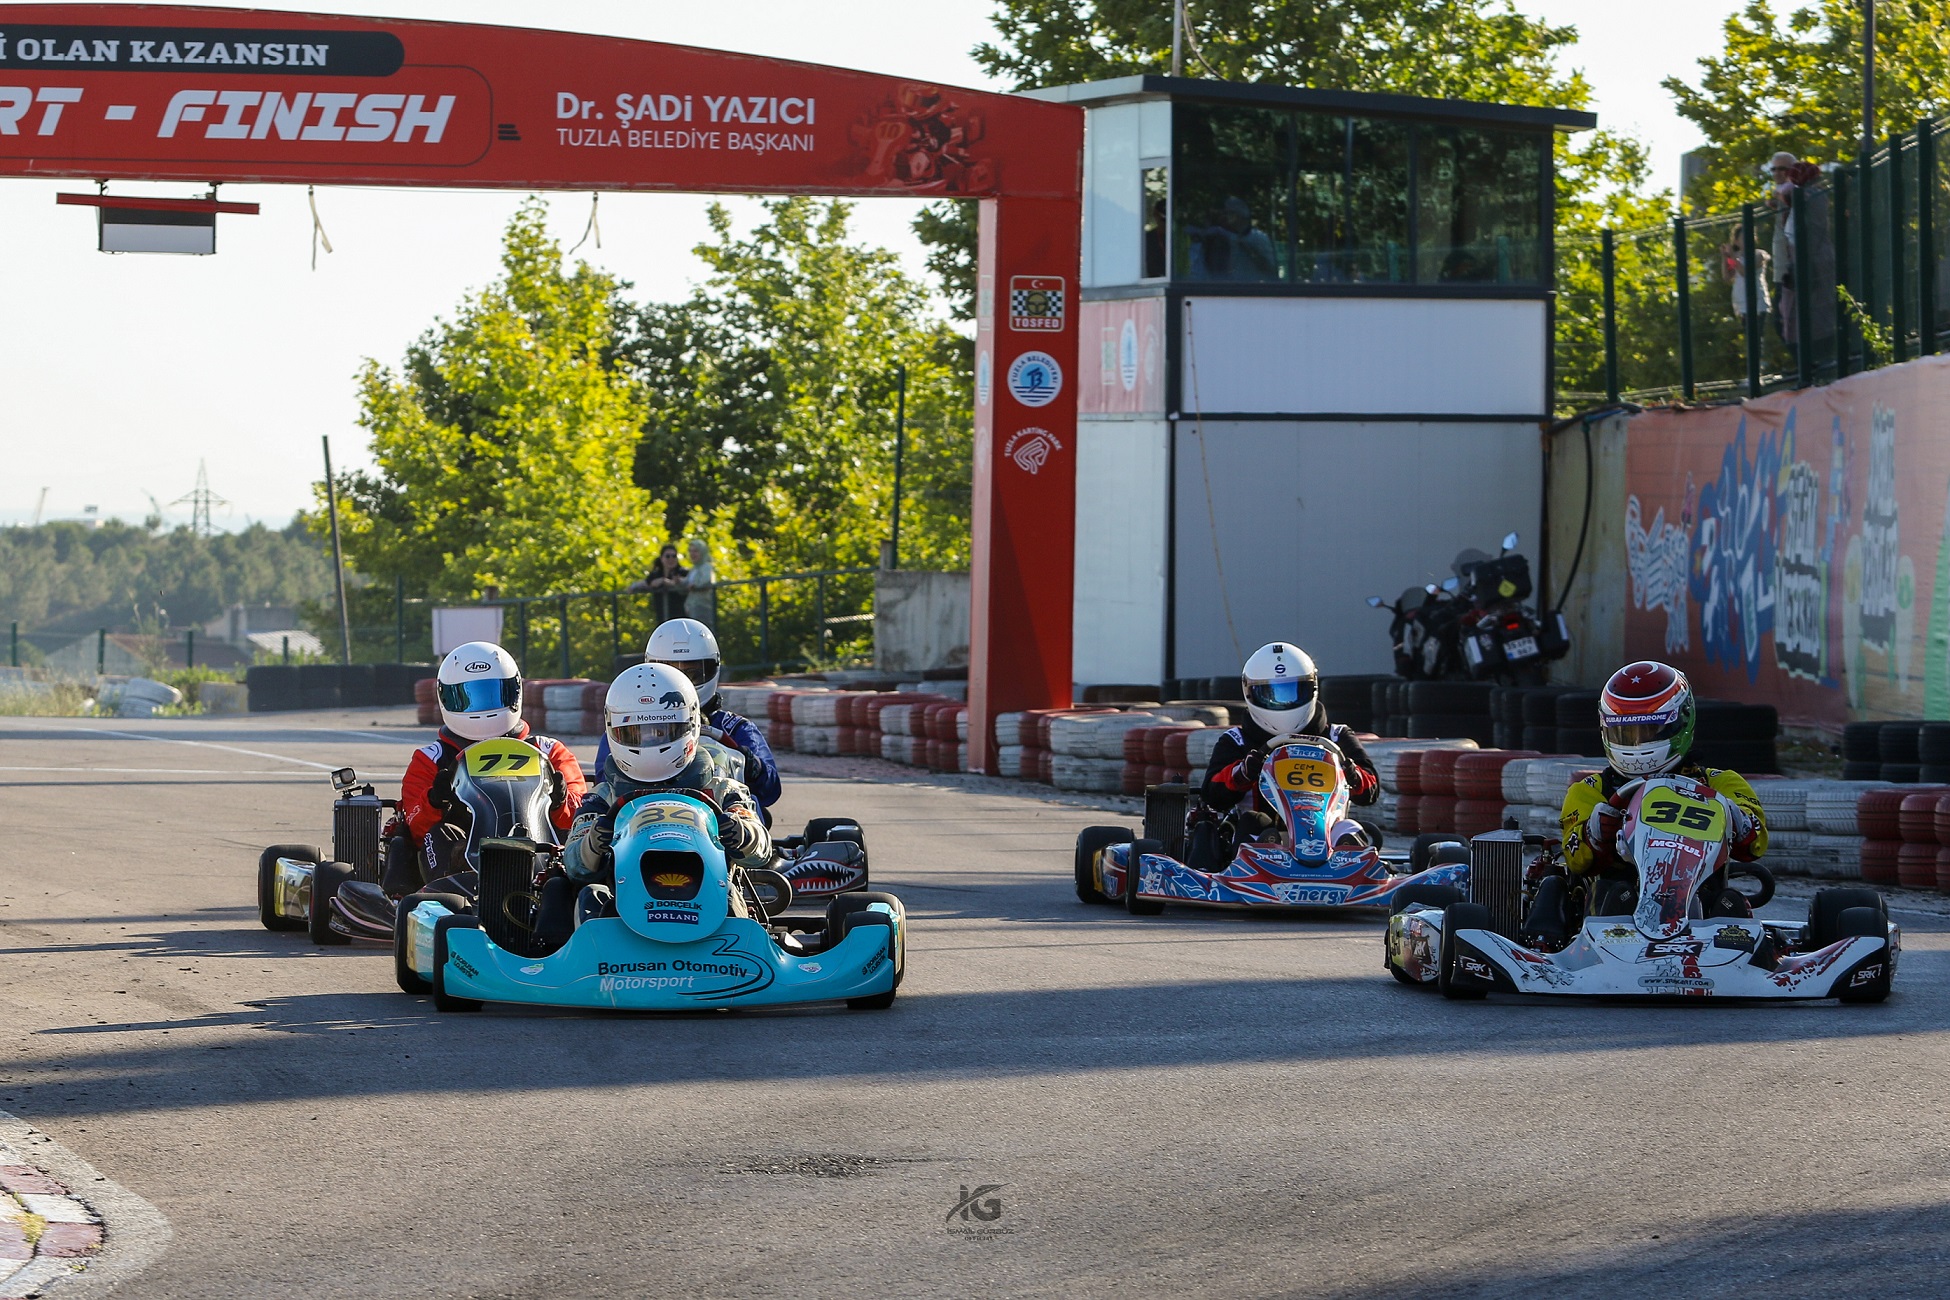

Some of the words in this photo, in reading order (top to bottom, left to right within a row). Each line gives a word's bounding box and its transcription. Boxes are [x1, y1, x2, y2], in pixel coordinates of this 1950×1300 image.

[17, 37, 120, 63] OLAN
[129, 40, 329, 67] KAZANSIN
[157, 89, 456, 144] FINISH
[556, 92, 603, 121] Dr.
[703, 95, 816, 126] YAZICI
[557, 127, 621, 149] TUZLA
[627, 124, 721, 151] BELEDİYE
[727, 132, 814, 155] BAŞKANI
[1014, 317, 1060, 329] TOSFED
[1011, 359, 1026, 383] TUZLA
[1004, 434, 1017, 458] TUZLA
[1047, 431, 1063, 451] PARK
[466, 662, 489, 671] Arai
[636, 713, 677, 723] Motorsport
[1621, 713, 1667, 723] KARTDROME
[478, 753, 531, 773] 77
[1293, 763, 1315, 771] CEM
[1286, 771, 1325, 787] 66
[1677, 788, 1702, 800] SRK
[635, 807, 701, 831] 34
[1645, 800, 1716, 832] 35
[1650, 839, 1702, 858] MOTUL
[656, 900, 703, 911] BORÇELİK
[648, 913, 699, 923] PORLAND
[1652, 943, 1698, 955] SRK
[455, 954, 480, 977] BORUSAN
[598, 960, 667, 976] Borusan
[672, 959, 748, 978] Otomotiv
[1465, 962, 1487, 972] SRK
[1857, 970, 1876, 979] SRK
[599, 975, 695, 992] Motorsport
